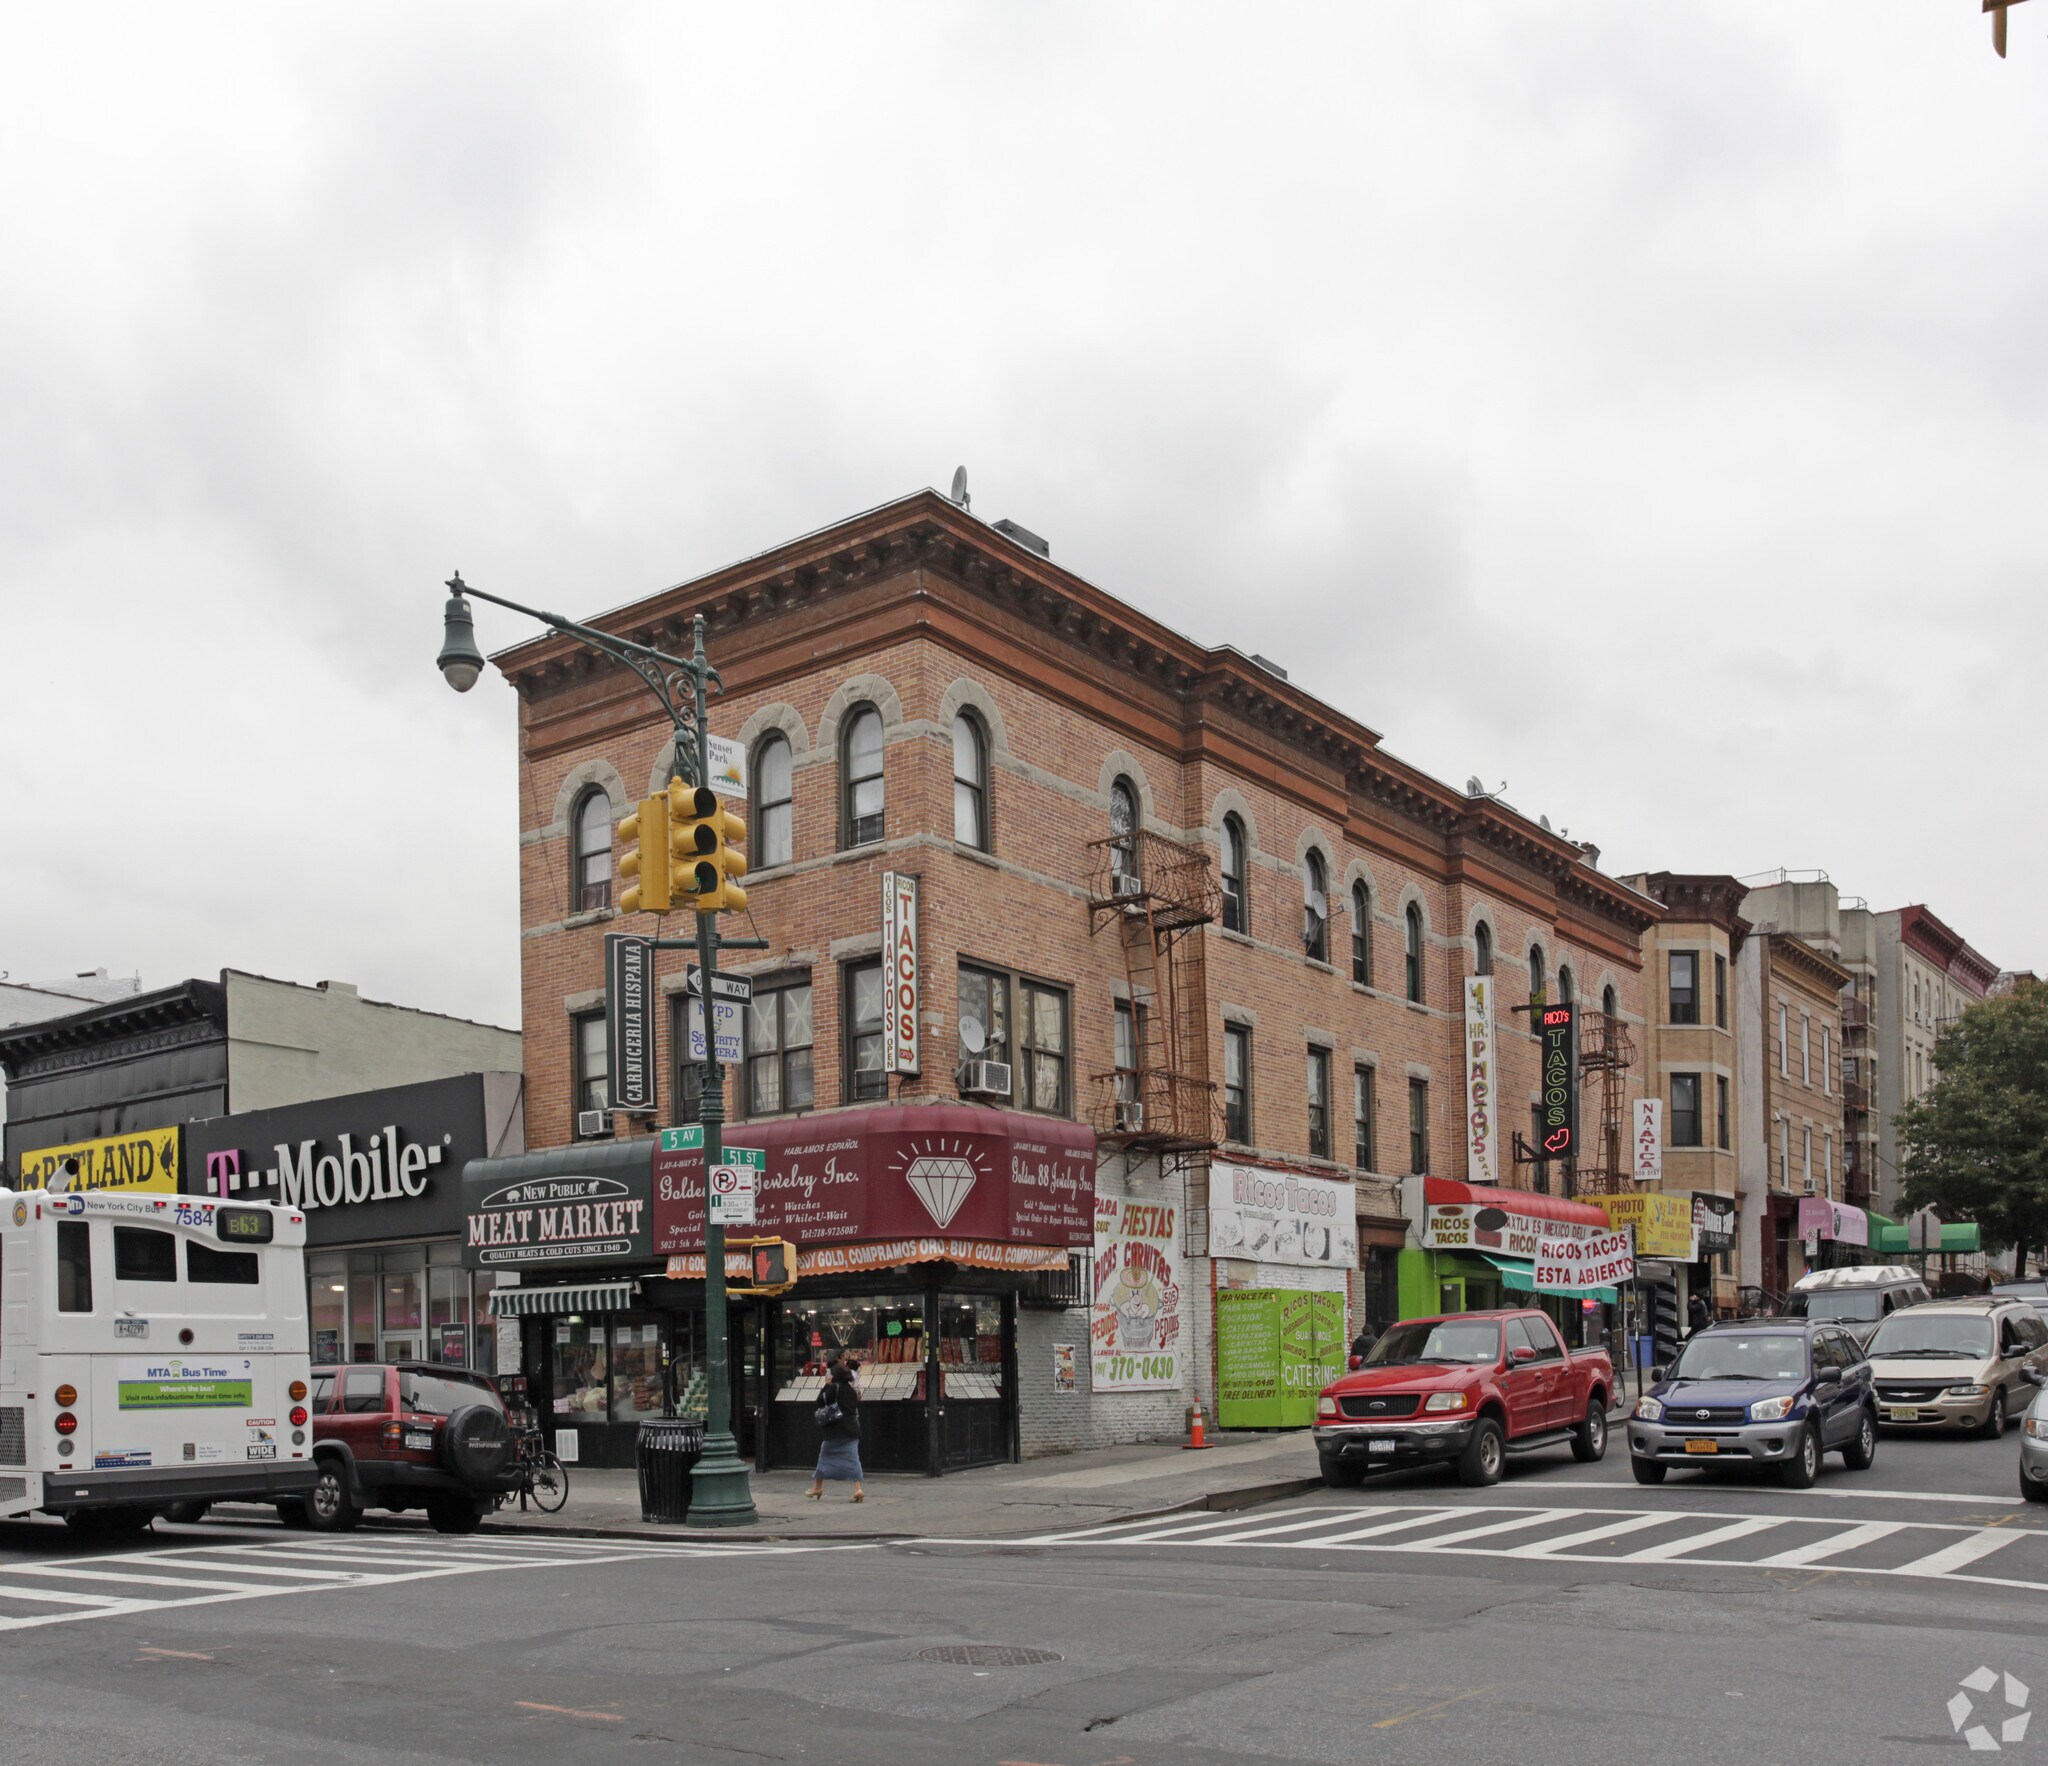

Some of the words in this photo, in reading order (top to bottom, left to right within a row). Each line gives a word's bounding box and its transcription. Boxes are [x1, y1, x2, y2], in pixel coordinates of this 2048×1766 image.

[709, 739, 732, 755] Sunset
[709, 749, 728, 764] Park
[897, 877, 914, 893] RICOS
[625, 944, 642, 1010] HISPANA
[885, 919, 894, 1032] TACOS
[898, 895, 915, 1042] TACOS
[726, 981, 747, 997] WAY
[625, 1012, 643, 1101] CARNICERIA
[900, 1050, 913, 1059] OPEN
[1546, 1028, 1567, 1126] TACOS
[670, 1131, 678, 1149] 5
[682, 1130, 695, 1142] AV
[784, 1144, 824, 1156] HABLAMOS
[826, 1139, 859, 1152] ESPAÑOL
[729, 1150, 741, 1165] 51
[746, 1152, 757, 1164] ST
[822, 1157, 859, 1185] Inc.
[1012, 1155, 1036, 1186] Golden
[1038, 1164, 1049, 1187] 88
[1050, 1161, 1077, 1201] Jewelry
[1079, 1165, 1093, 1191] Inc.
[1232, 1168, 1285, 1211] Ricos
[1285, 1177, 1337, 1218] Tacos
[69, 1198, 83, 1212] MTA
[87, 1200, 106, 1210] New
[107, 1202, 125, 1211] York
[127, 1203, 143, 1213] City
[145, 1205, 161, 1213] Bus
[784, 1201, 821, 1211] Watches
[1610, 1198, 1645, 1214] PHOTO
[174, 1209, 213, 1227] 7584
[229, 1216, 258, 1234] B63
[467, 1210, 533, 1247] MEAT
[538, 1199, 643, 1242] MARKET
[785, 1210, 848, 1224] While-U-Wait
[1094, 1197, 1118, 1217] PARA
[1120, 1203, 1175, 1239] FIESTAS
[1430, 1217, 1470, 1231] RICOS
[669, 1223, 701, 1234] Special
[1094, 1220, 1110, 1233] SUS
[1532, 1219, 1542, 1235] ES
[1543, 1221, 1570, 1239] MEXICO
[660, 1240, 676, 1249] 5023
[679, 1238, 690, 1248] 5th
[1435, 1232, 1469, 1244] TACOS
[1541, 1242, 1582, 1260] RICOS
[1584, 1233, 1628, 1259] TACOS
[489, 1250, 517, 1260] QUALITY
[517, 1249, 539, 1259] MEATS
[540, 1248, 545, 1257] &
[546, 1247, 563, 1256] COLD
[564, 1246, 582, 1255] CUTS
[582, 1244, 602, 1254] SINCE
[603, 1243, 621, 1252] 1940
[817, 1248, 849, 1268] GOLD,
[848, 1241, 917, 1264] COMPRAMOS
[919, 1238, 945, 1255] ORO
[950, 1239, 974, 1257] BUY
[975, 1246, 1003, 1264] GOLD,
[669, 1256, 687, 1272] BUY
[1094, 1243, 1117, 1300] RICAS
[1123, 1241, 1172, 1288] CARNITAS
[1536, 1266, 1572, 1284] ESTA
[1577, 1257, 1633, 1285] ABIERTO
[1220, 1292, 1274, 1302] BANQUETES
[1093, 1303, 1111, 1312] PARA
[1223, 1304, 1240, 1312] PARA
[1242, 1303, 1263, 1311] TODA
[1283, 1294, 1309, 1322] RICOS
[1313, 1294, 1337, 1315] TACOS
[1092, 1310, 1119, 1342] PEDIDOS
[1154, 1314, 1179, 1339] PEDIDOS
[1225, 1313, 1262, 1323] OCASION
[1314, 1311, 1335, 1332] TORTAS
[1226, 1323, 1264, 1334] CATERING
[443, 1341, 463, 1358] 4G
[1283, 1342, 1307, 1360] NACHOS
[147, 1368, 170, 1377] MTA
[182, 1368, 200, 1377] Bus
[203, 1367, 228, 1377] Time
[1108, 1356, 1174, 1381] 370-0430
[1284, 1364, 1338, 1387] CATERING
[160, 1385, 187, 1393] Where's
[199, 1385, 215, 1393] bus?
[1223, 1390, 1241, 1400] FREE
[1241, 1389, 1277, 1400] DELIVERY
[249, 1446, 275, 1455] WIDE
